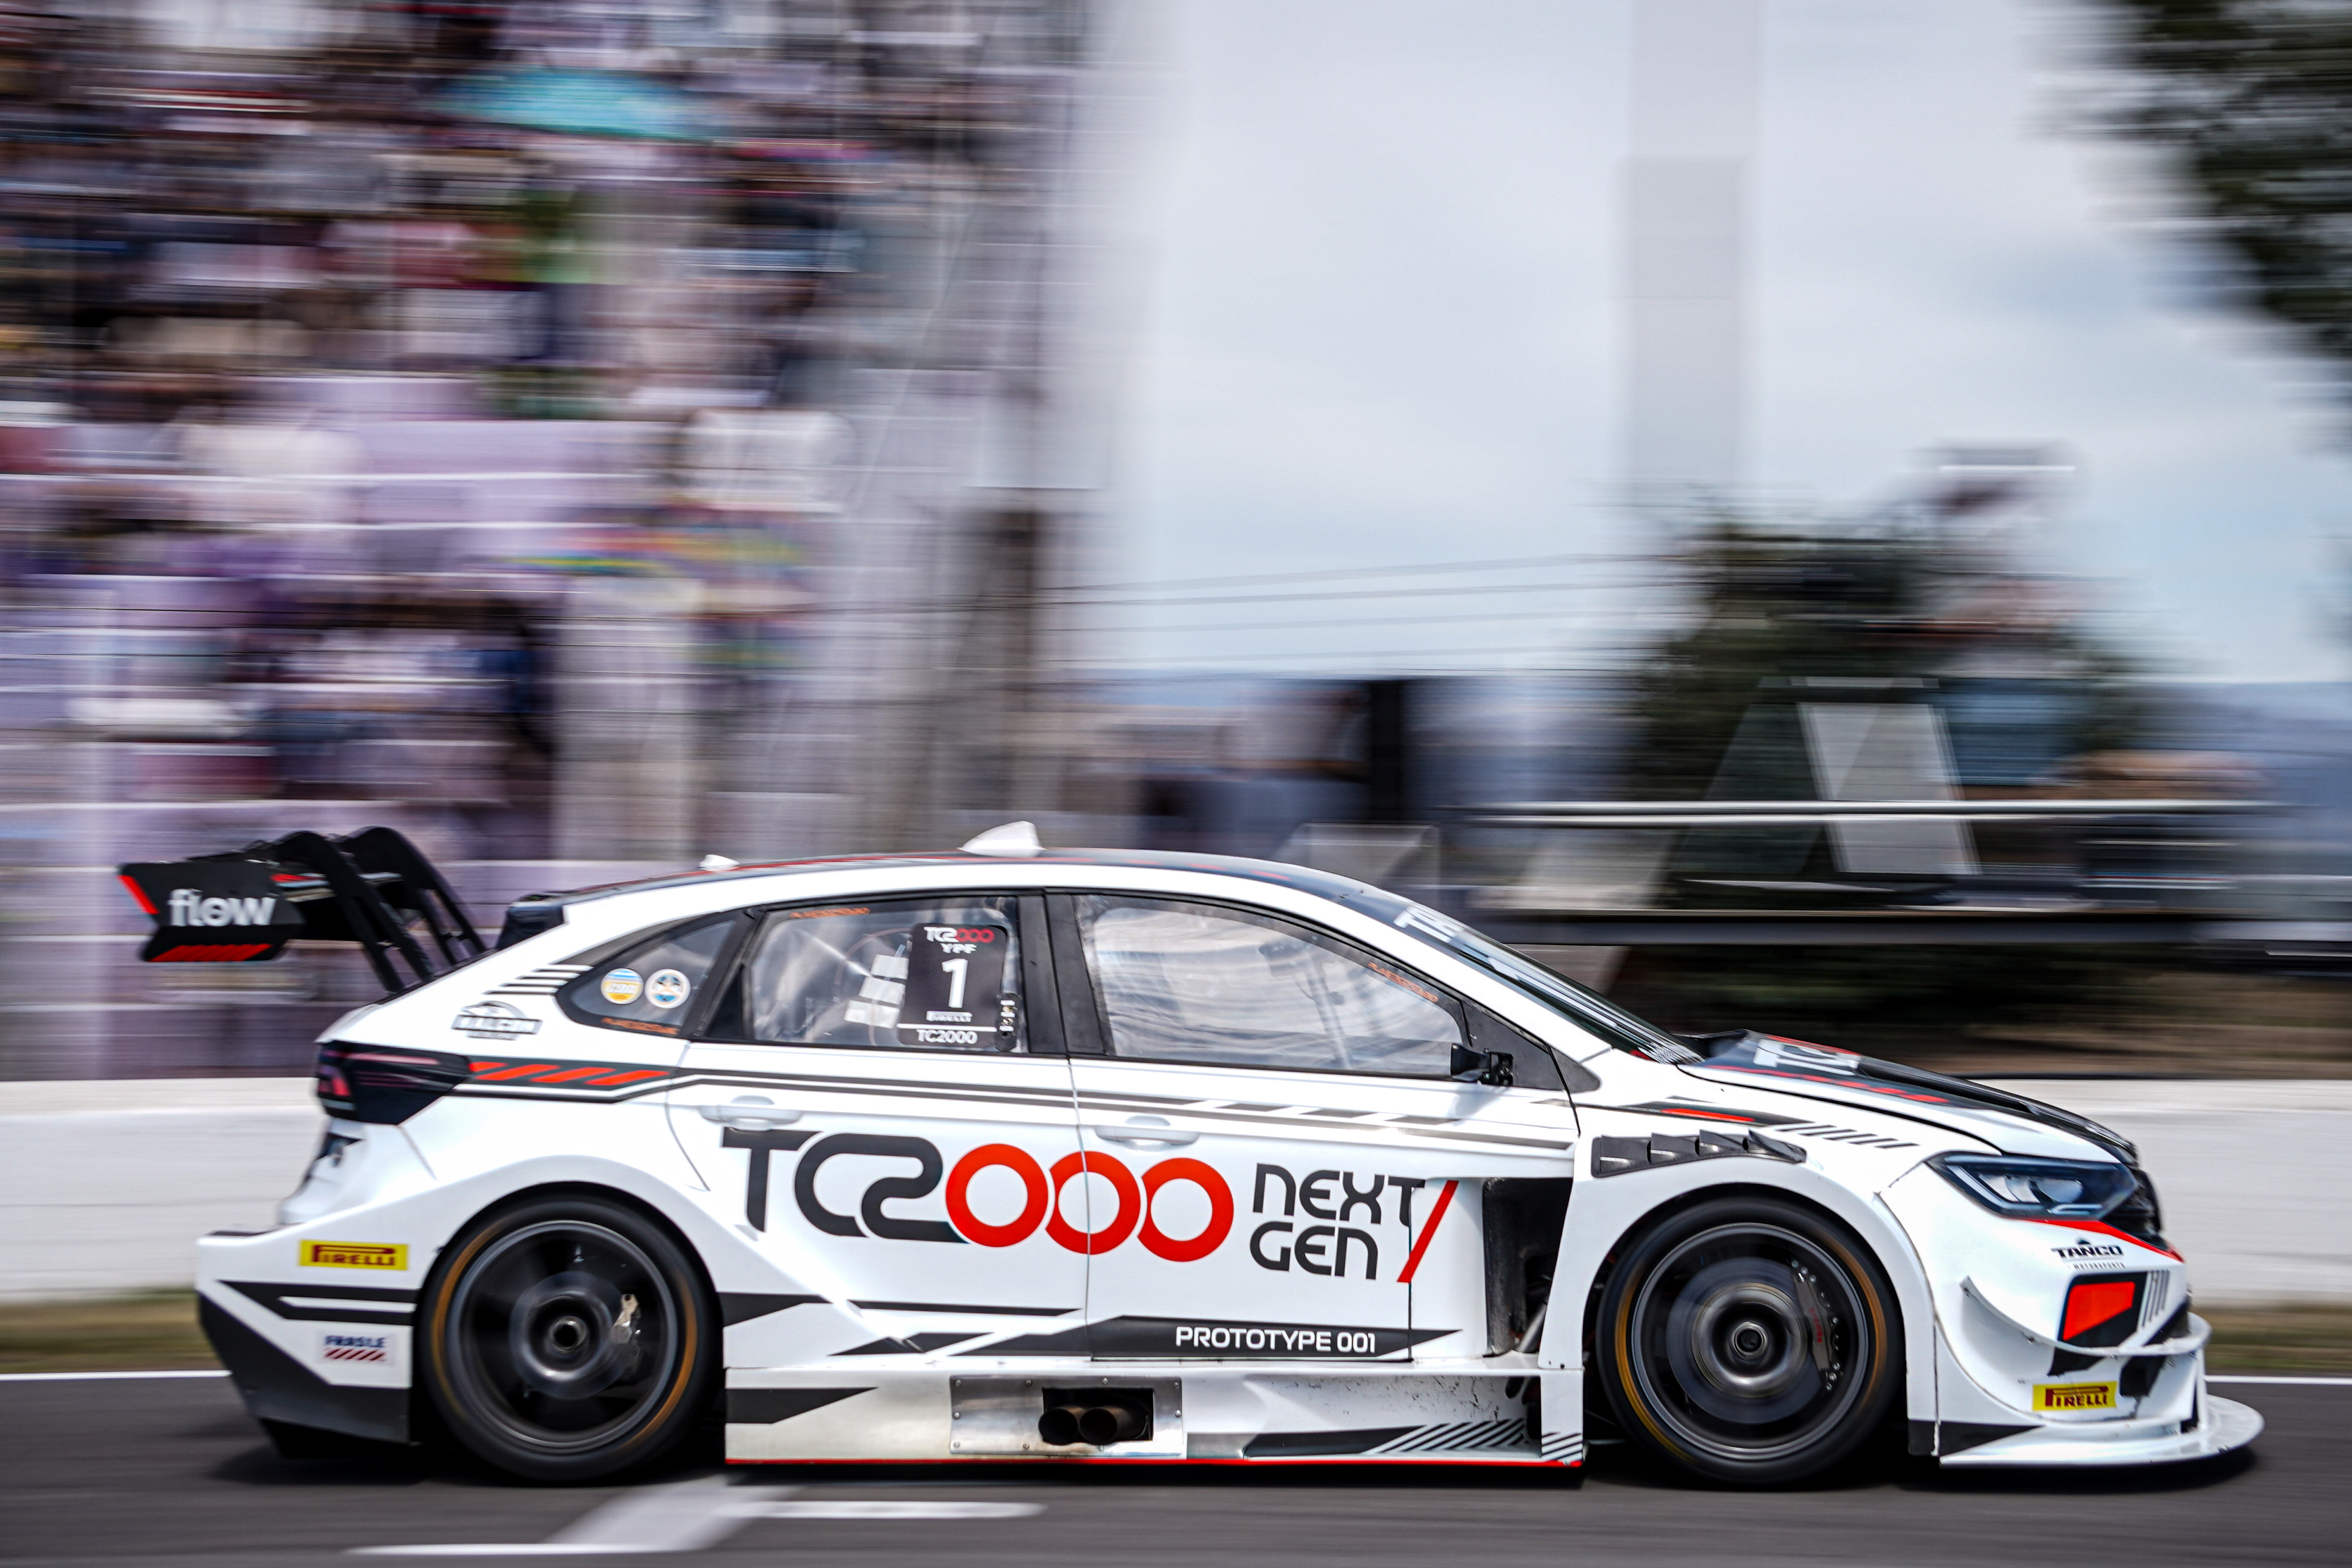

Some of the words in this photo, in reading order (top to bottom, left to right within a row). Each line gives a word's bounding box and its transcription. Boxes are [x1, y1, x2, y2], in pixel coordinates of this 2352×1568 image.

[166, 889, 277, 927] flow
[924, 927, 995, 943] TC2000
[941, 943, 977, 954] YPF
[942, 958, 968, 1008] 1
[916, 1029, 978, 1044] TC2000
[722, 1126, 1235, 1262] TC2000
[1252, 1163, 1425, 1227] NEXT
[312, 1245, 396, 1266] PIRELLI
[1250, 1220, 1379, 1280] GEN
[2050, 1245, 2125, 1260] TANGO
[1175, 1326, 1332, 1353] PROTOTYPE
[1337, 1333, 1376, 1353] 001
[2045, 1385, 2109, 1407] PIRELLI
